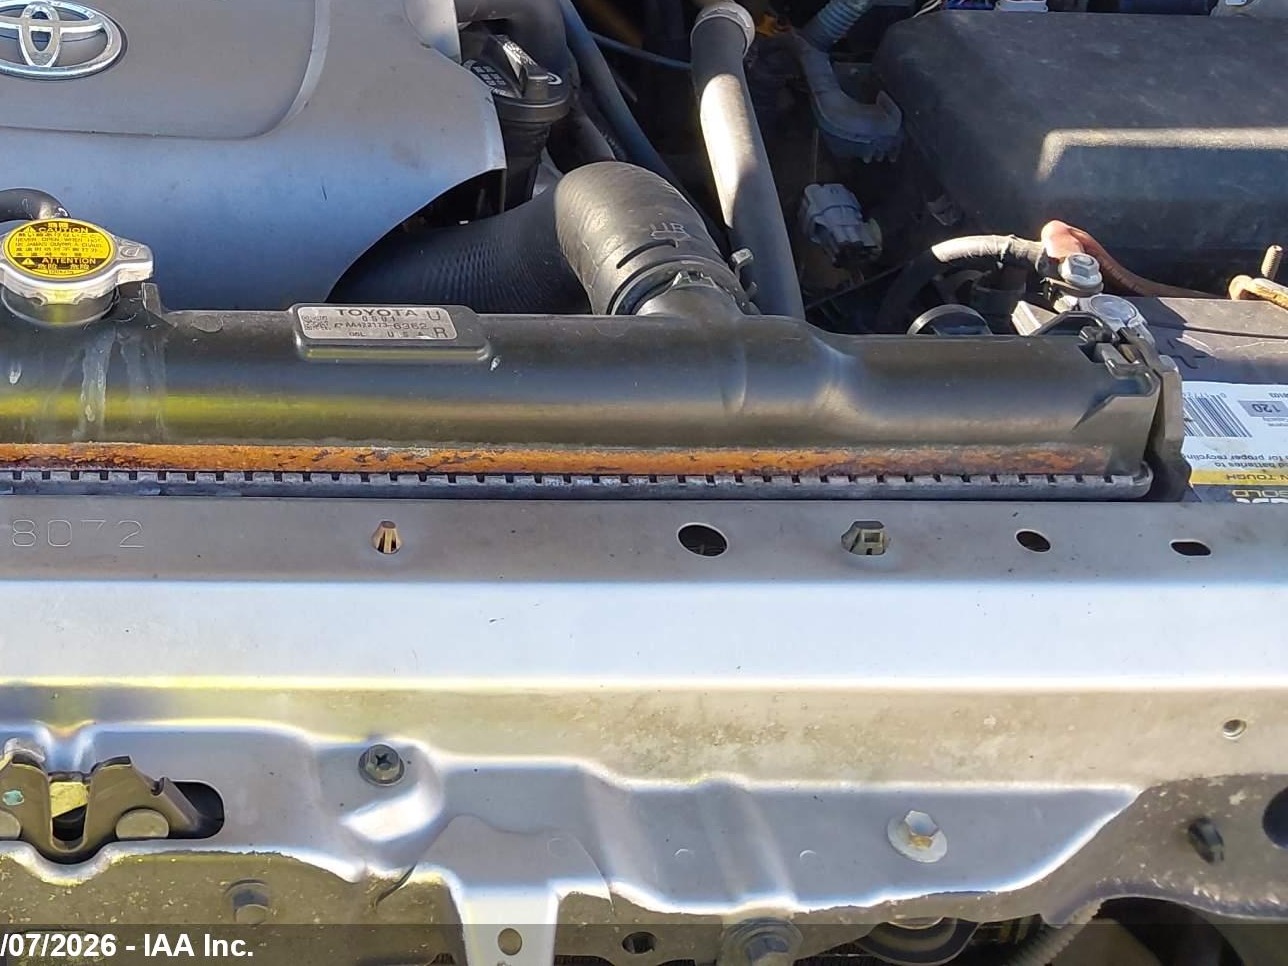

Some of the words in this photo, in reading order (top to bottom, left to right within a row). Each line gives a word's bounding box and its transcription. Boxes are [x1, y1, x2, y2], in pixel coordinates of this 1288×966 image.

[337, 308, 418, 317] TOYOTA
[426, 310, 441, 321] U
[433, 327, 449, 338] R
[1252, 403, 1281, 413] 120
[1230, 453, 1265, 461] proper
